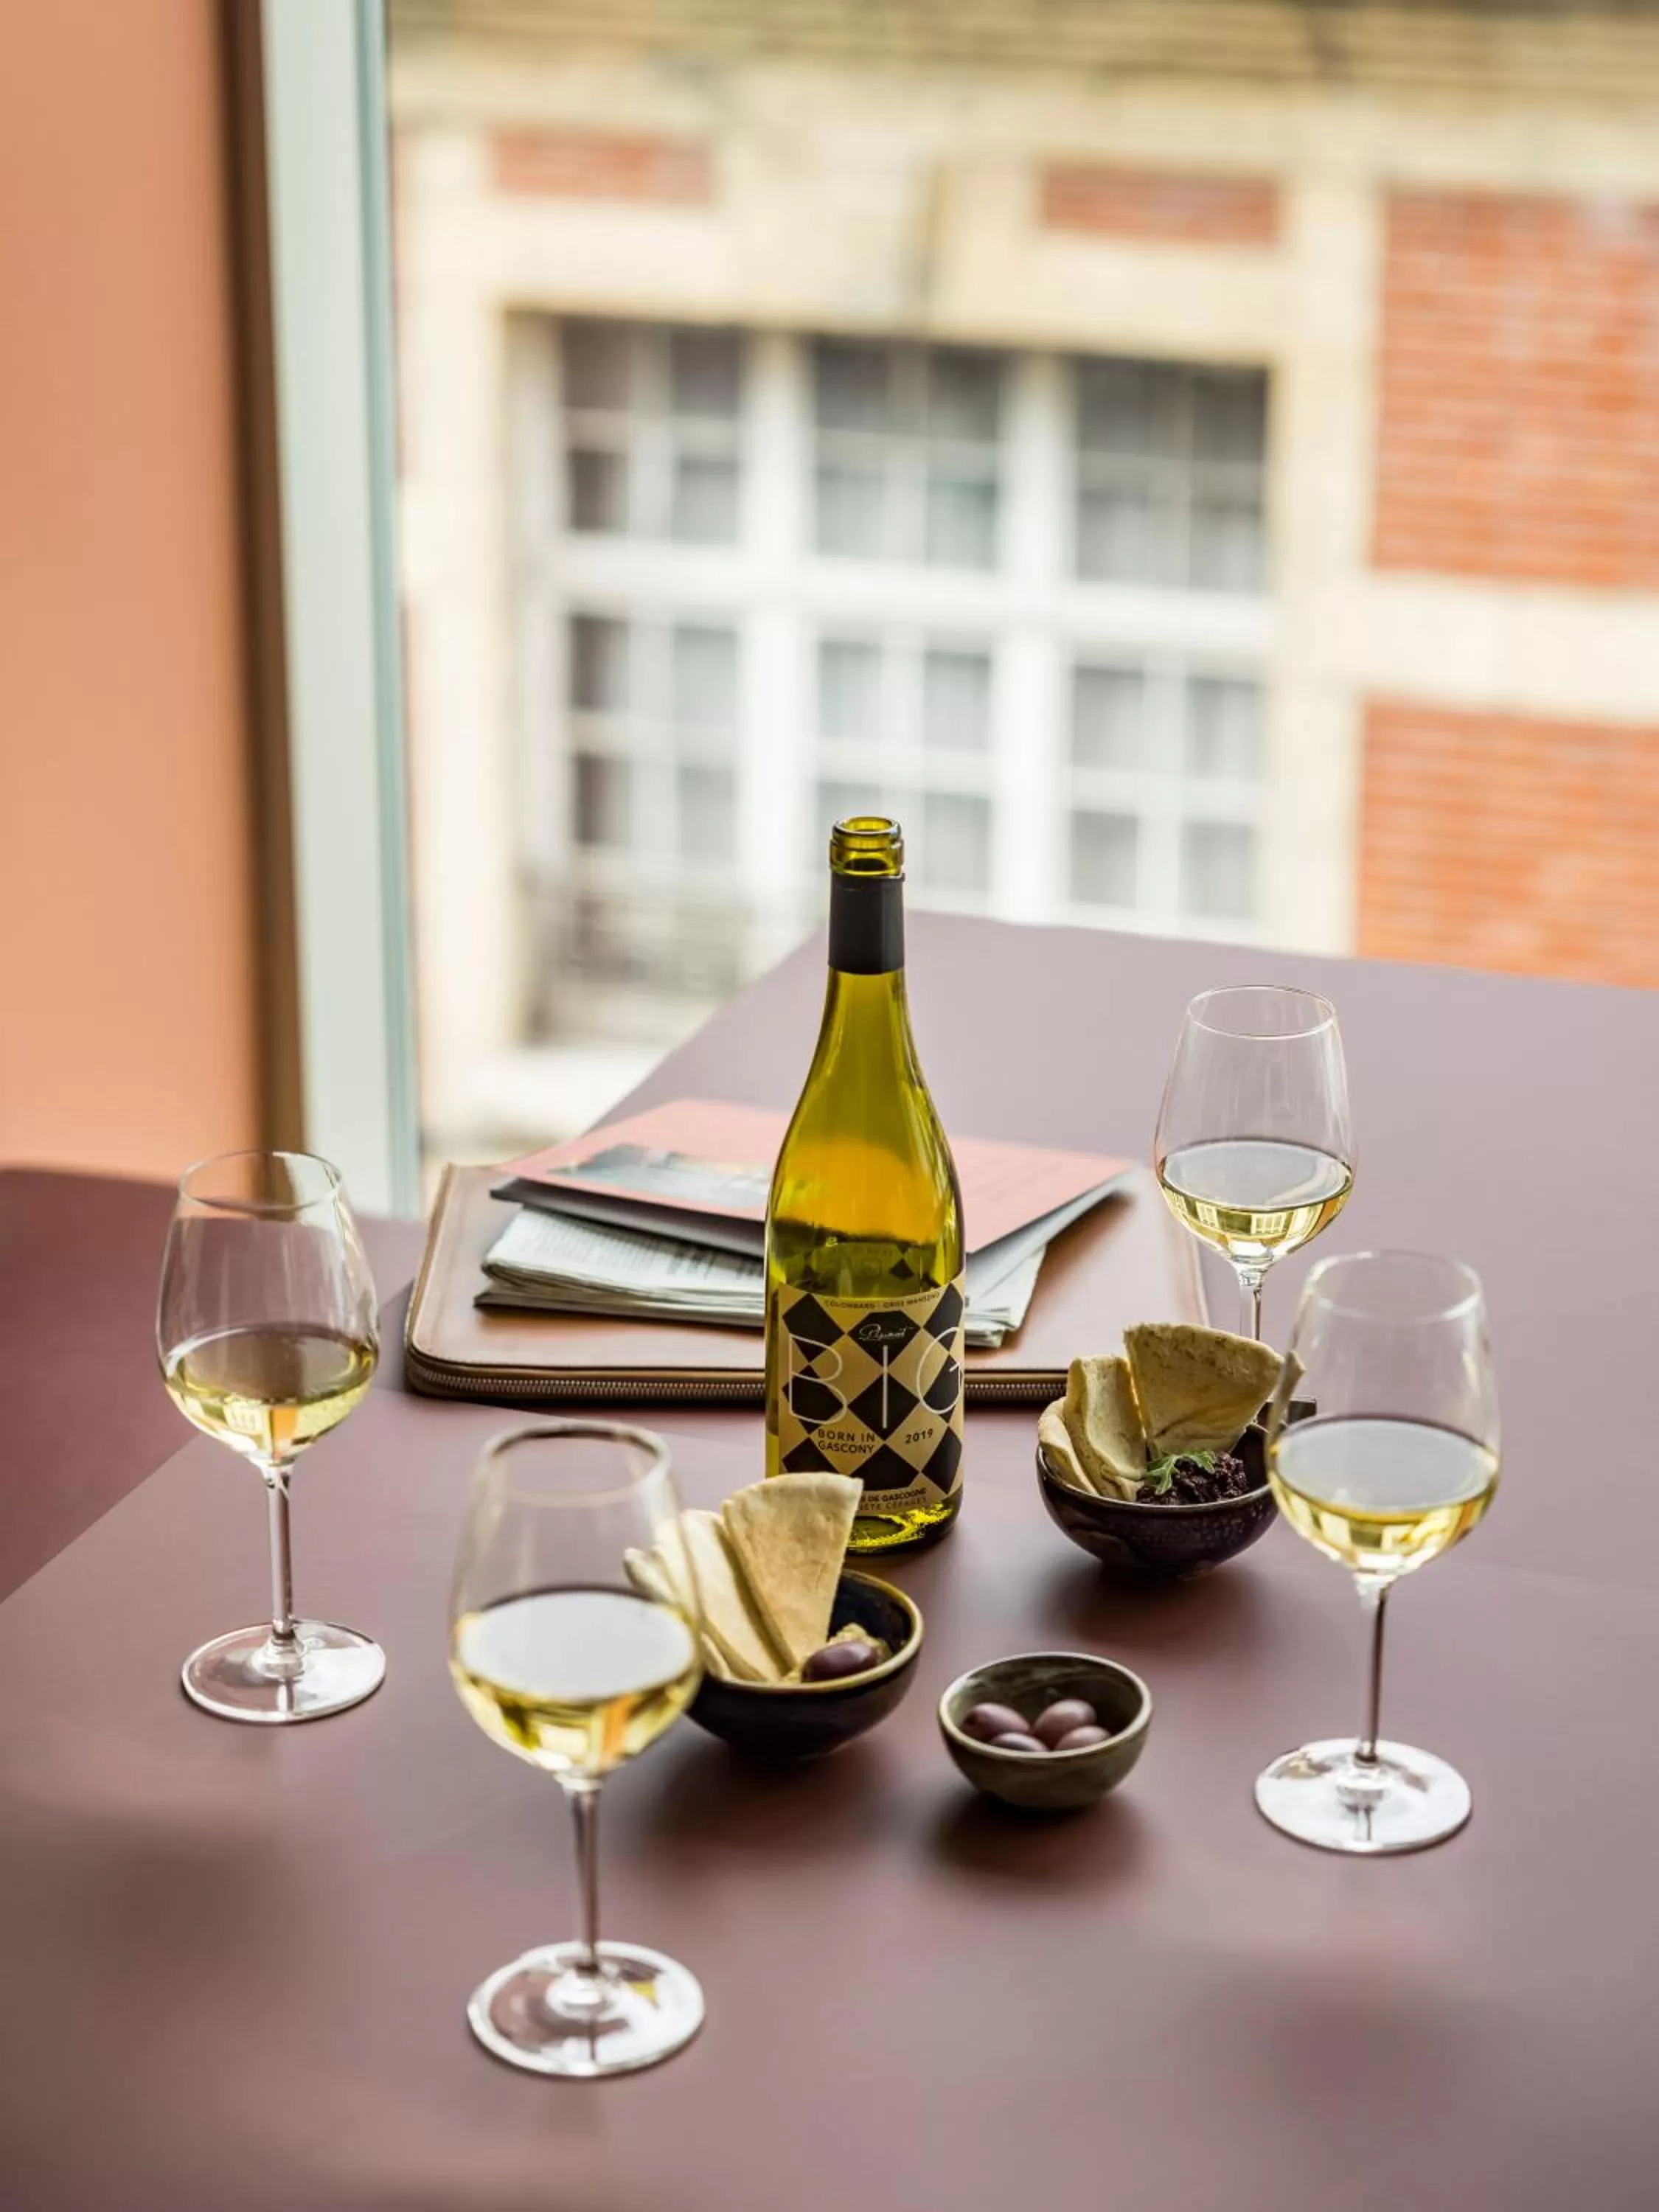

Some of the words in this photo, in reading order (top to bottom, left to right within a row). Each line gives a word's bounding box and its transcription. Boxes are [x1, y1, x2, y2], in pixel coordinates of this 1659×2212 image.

[788, 1327, 964, 1428] BIG
[818, 1429, 855, 1442] BORN
[861, 1433, 875, 1443] IN
[905, 1428, 933, 1444] 2019
[818, 1440, 874, 1453] GASCONY
[869, 1495, 880, 1503] DE
[882, 1487, 927, 1502] GASCOGNE
